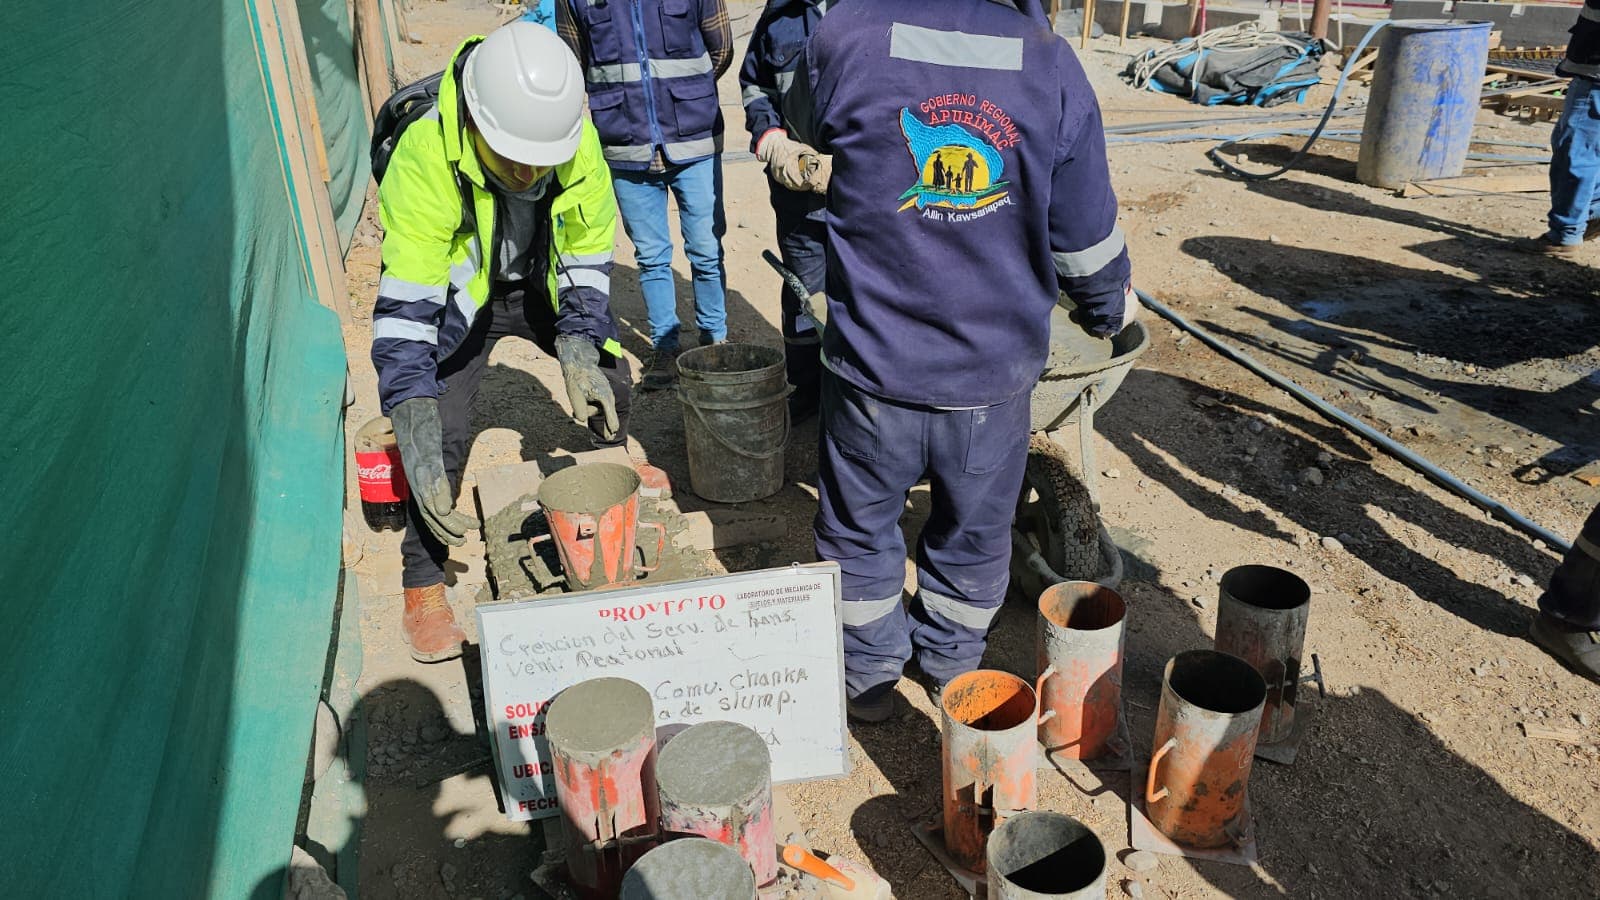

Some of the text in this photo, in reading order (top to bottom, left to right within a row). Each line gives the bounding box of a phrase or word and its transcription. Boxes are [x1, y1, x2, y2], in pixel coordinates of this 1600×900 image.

[920, 93, 1021, 148] GOBIERNO REGIONAL
[929, 109, 1009, 151] APURÍMAC
[922, 207, 943, 221] Allin
[736, 588, 775, 600] LABORATORIO
[777, 594, 811, 605] MATERIALES
[603, 625, 636, 645] del
[714, 614, 739, 633] de
[680, 701, 703, 717] de
[512, 761, 553, 779] UBIC
